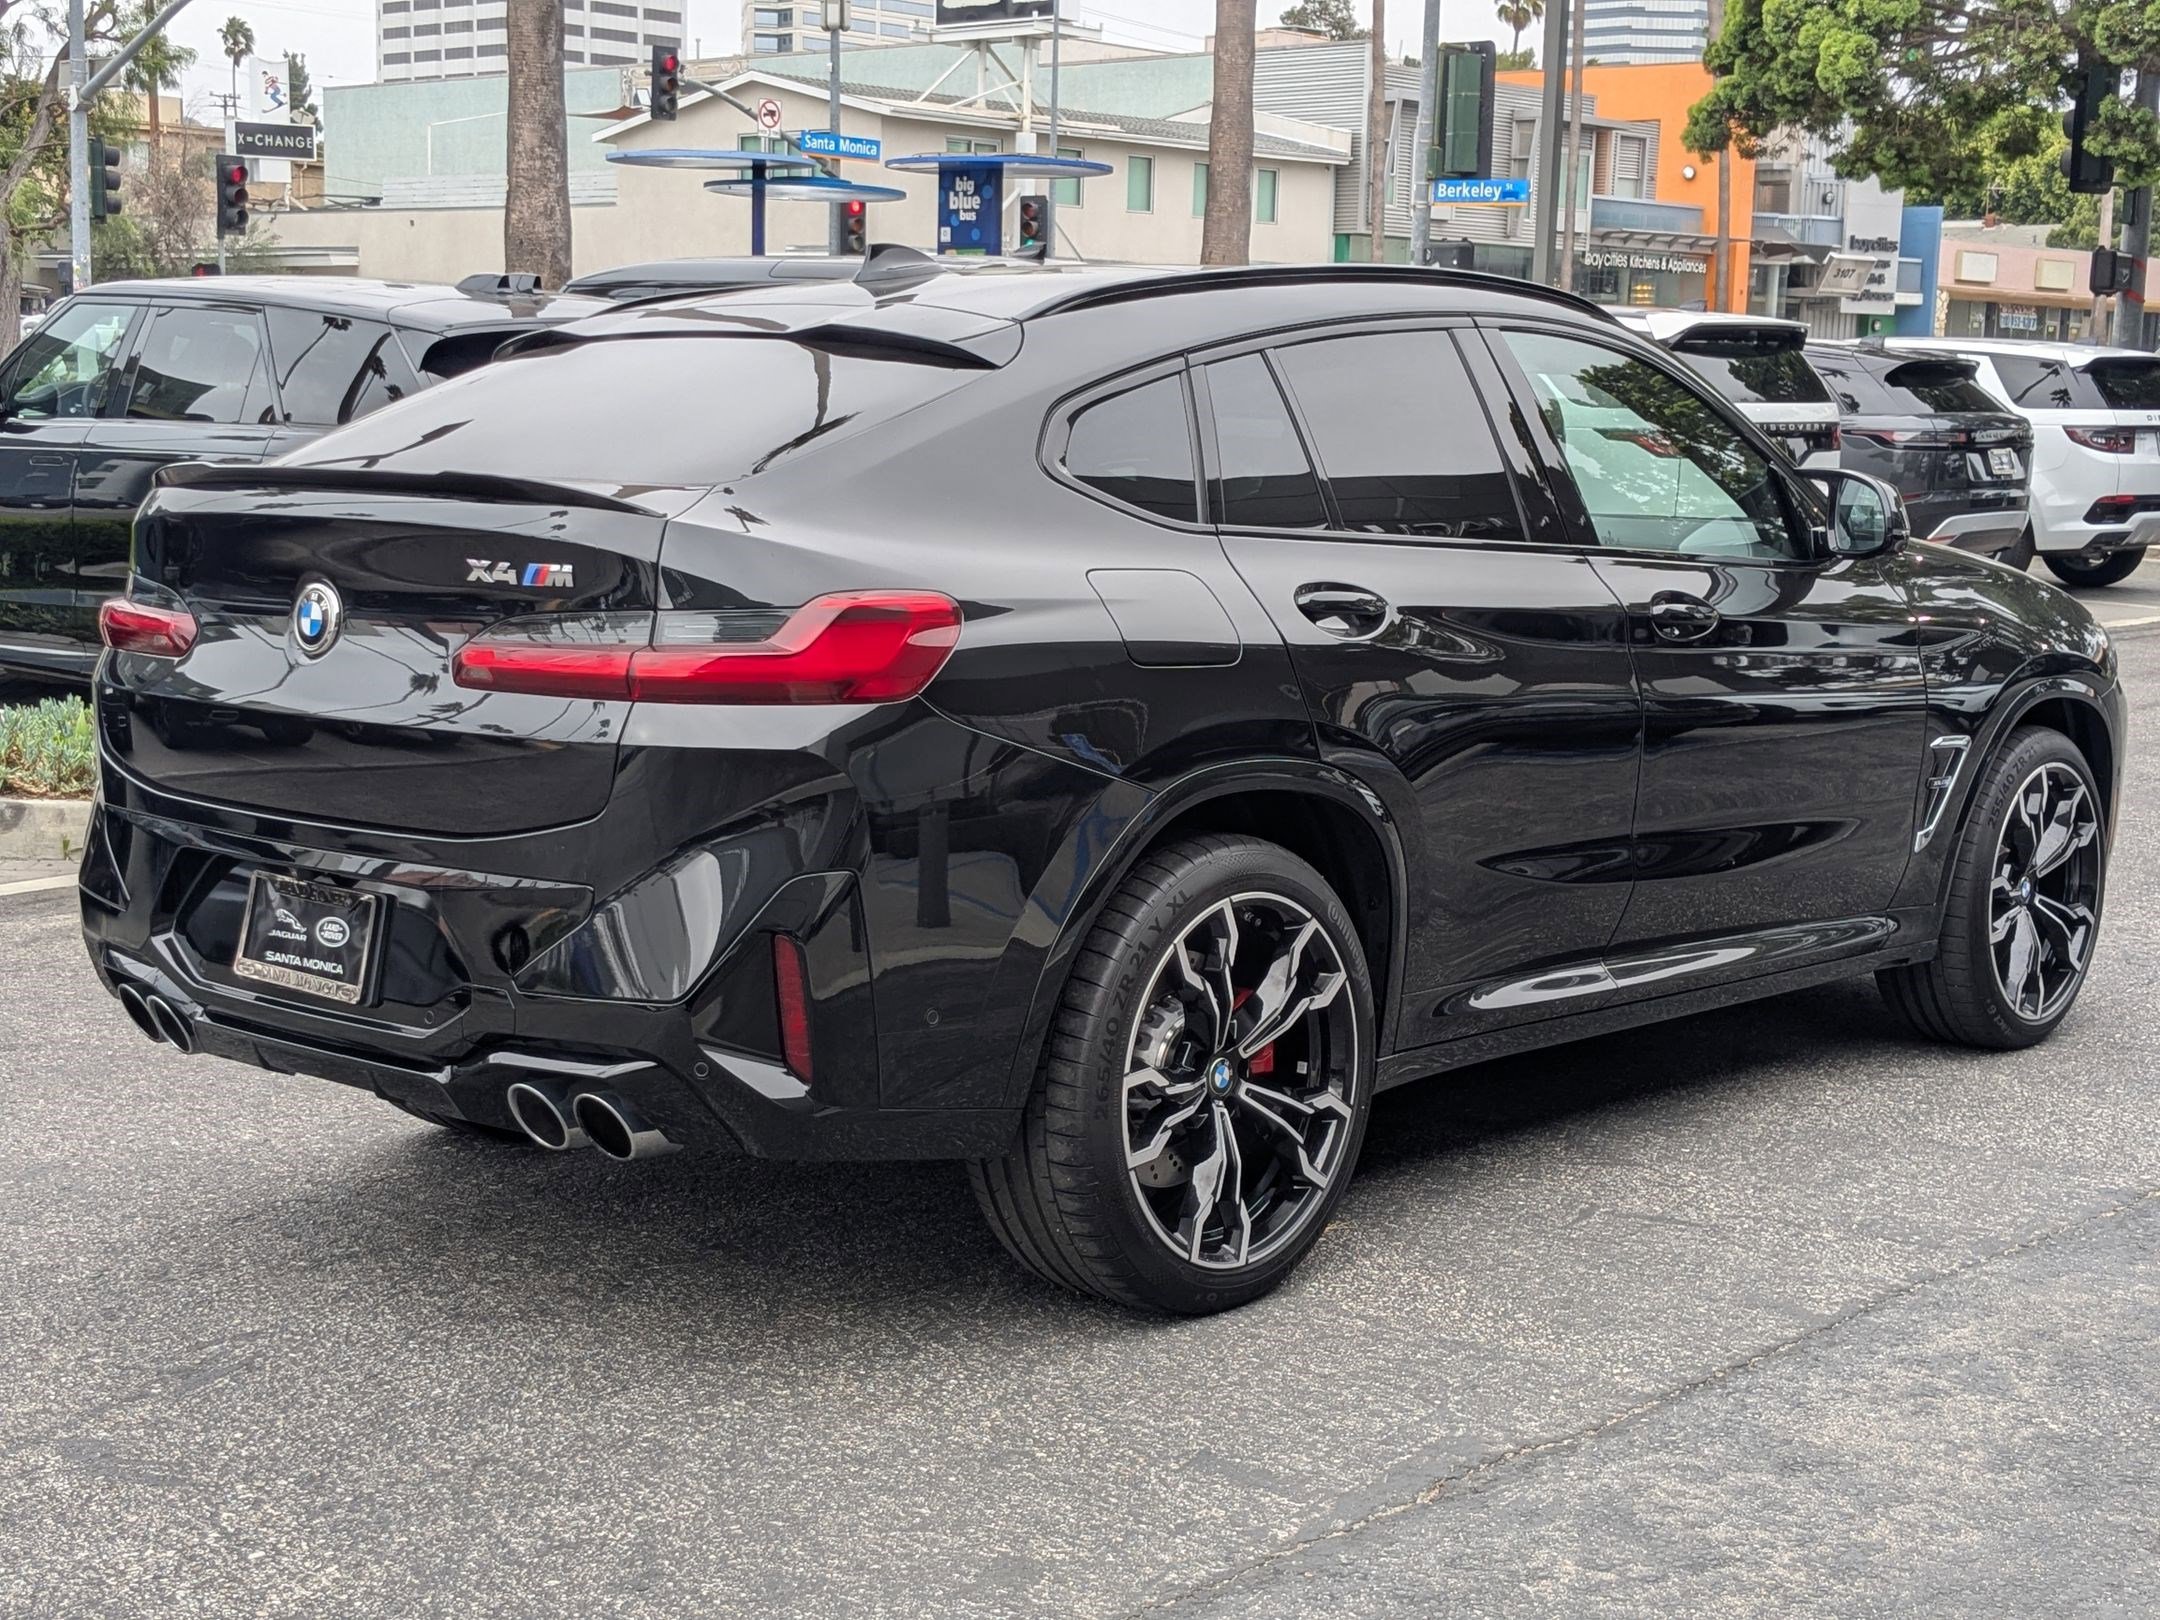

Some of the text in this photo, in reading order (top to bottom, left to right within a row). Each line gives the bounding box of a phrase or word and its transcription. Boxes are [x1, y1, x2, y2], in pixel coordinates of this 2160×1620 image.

[237, 133, 313, 149] X-CHANGE
[805, 135, 877, 156] Santa Monica
[955, 176, 975, 195] big
[1438, 182, 1502, 201] Berkeley
[949, 191, 981, 210] blue
[960, 210, 976, 221] bus
[1630, 255, 1660, 270] Kitchens
[1661, 257, 1667, 270] &
[1668, 258, 1707, 274] Appliances
[1833, 267, 1856, 278] 3107
[465, 558, 518, 585] X4
[268, 930, 308, 942] JAGUAR
[321, 931, 343, 941] ROVER
[323, 922, 343, 932] LAND
[1112, 976, 1135, 1011] ZR
[1129, 940, 1151, 971] 21
[1167, 889, 1194, 916] XL
[265, 950, 344, 975] SANTA MONICA
